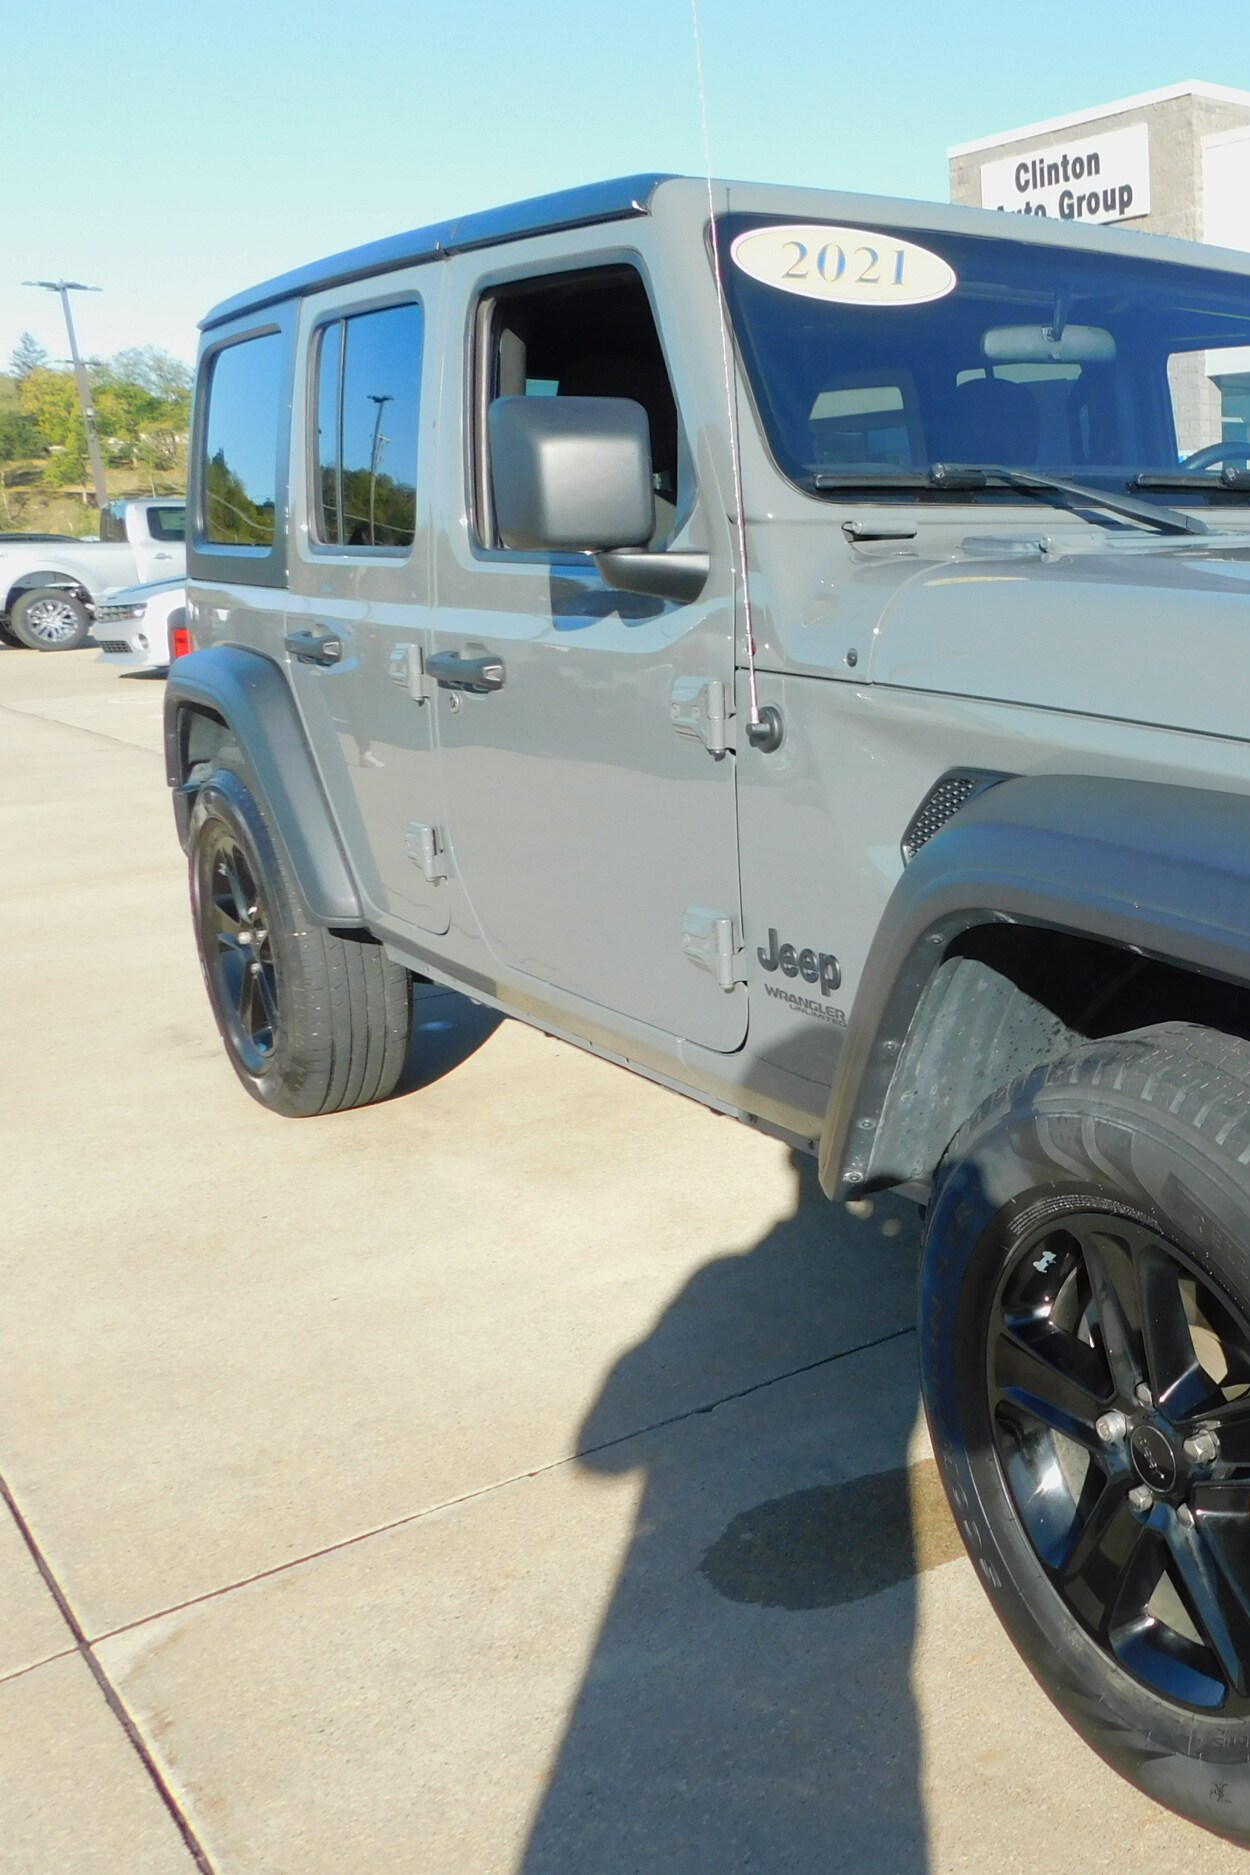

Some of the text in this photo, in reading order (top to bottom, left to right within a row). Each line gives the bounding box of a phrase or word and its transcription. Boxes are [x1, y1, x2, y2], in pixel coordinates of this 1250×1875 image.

[1014, 151, 1101, 193] Clinton
[1058, 184, 1133, 219] Group
[780, 240, 906, 286] 2021
[757, 927, 842, 998] Jeep
[763, 983, 846, 1022] WRANGLER
